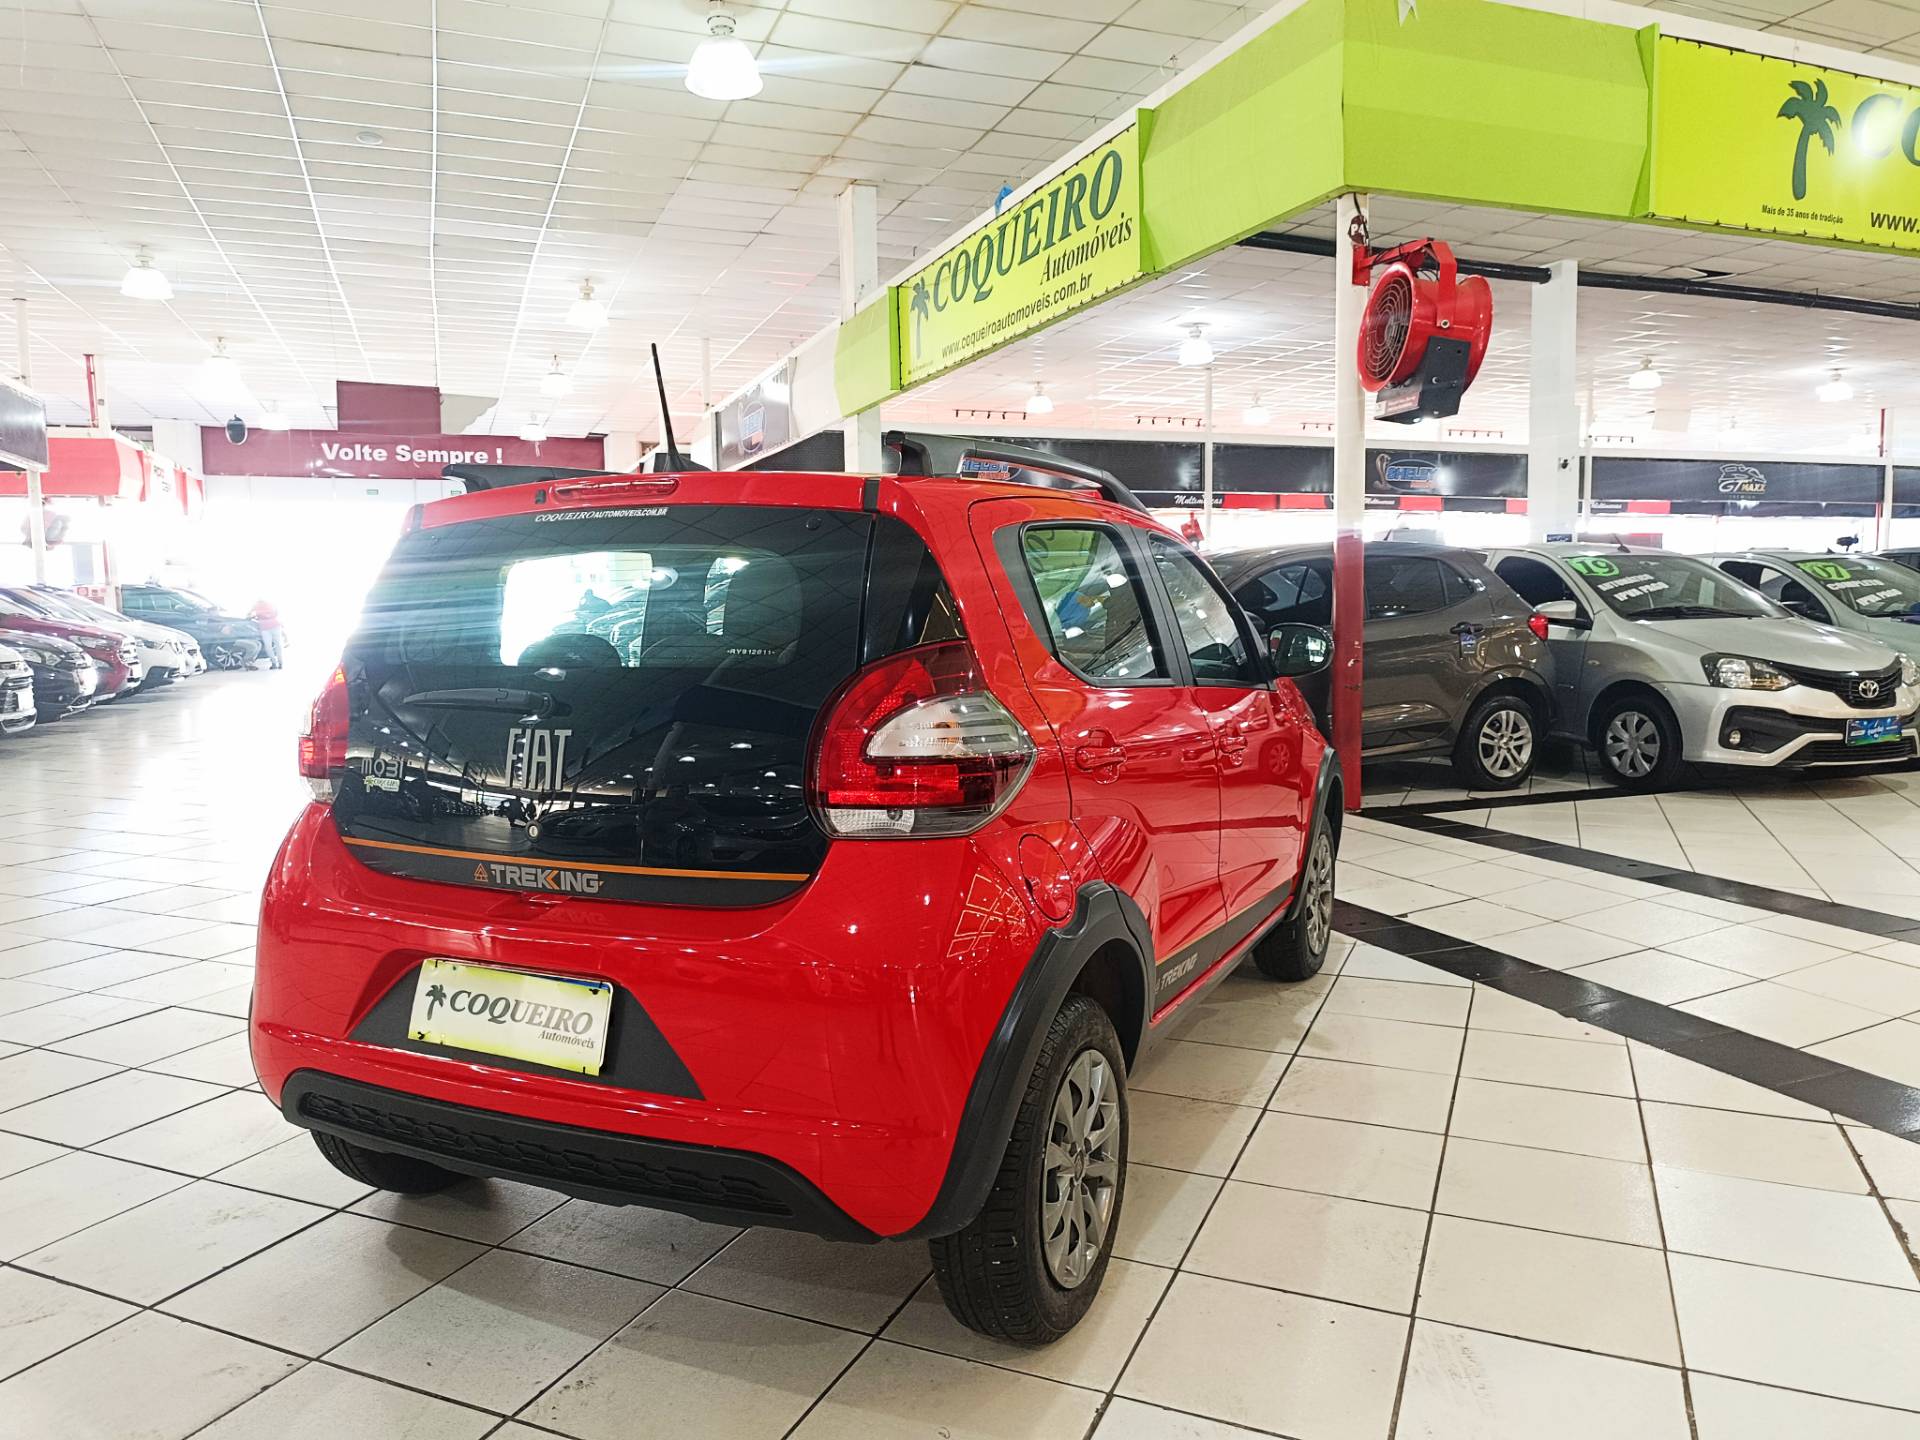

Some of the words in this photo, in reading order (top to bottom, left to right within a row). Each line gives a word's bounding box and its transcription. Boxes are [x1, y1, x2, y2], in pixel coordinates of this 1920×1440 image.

[933, 150, 1123, 313] COQUEIRO
[1761, 204, 1776, 216] Mais
[1777, 207, 1785, 216] de
[1786, 208, 1794, 217] 35
[1795, 210, 1809, 220] anos
[1810, 211, 1818, 221] de
[1040, 212, 1133, 285] Automóveis
[941, 272, 1093, 358] www.coqueiroautomoveis.com.br
[321, 442, 388, 461] Volte
[395, 444, 489, 464] Sempre
[1576, 560, 1615, 575] 19
[504, 727, 572, 791] FIAT
[490, 863, 601, 894] TREKKING
[449, 989, 594, 1035] COQUEIRO
[538, 1029, 595, 1050] Automóveis
